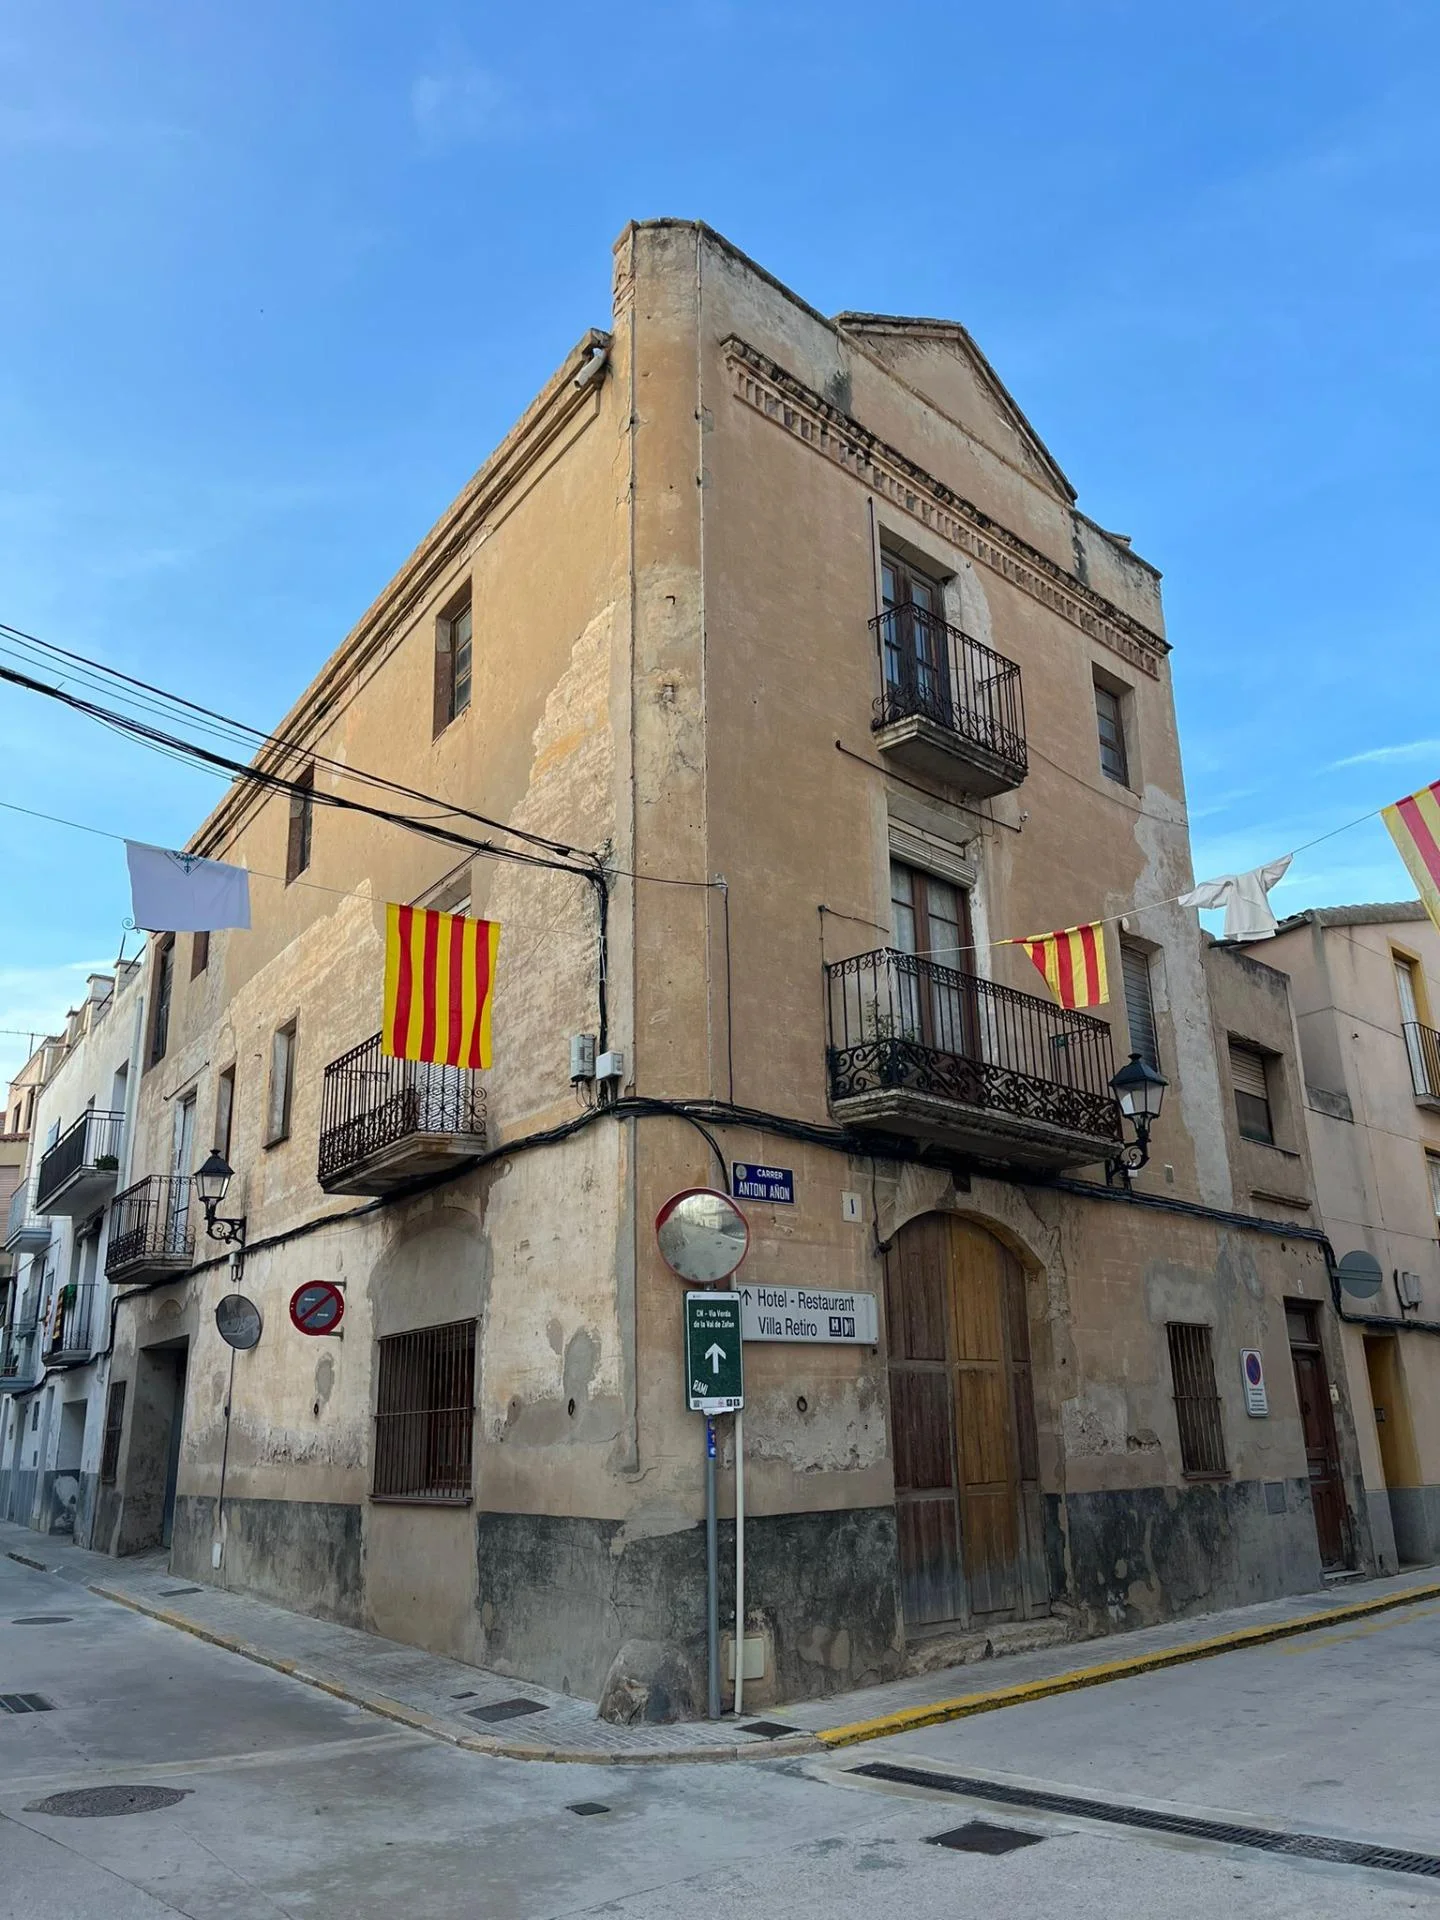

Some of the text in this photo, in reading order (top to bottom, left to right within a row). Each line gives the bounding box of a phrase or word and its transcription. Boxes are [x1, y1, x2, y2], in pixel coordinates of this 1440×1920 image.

[757, 1168, 783, 1180] CARRER
[738, 1181, 790, 1201] ANTONI AÑON
[757, 1289, 787, 1308] Hotel
[798, 1292, 855, 1312] Restaurant
[693, 1320, 700, 1328] de
[700, 1320, 706, 1328] la
[714, 1320, 721, 1328] de
[758, 1316, 817, 1336] Villa Retiro
